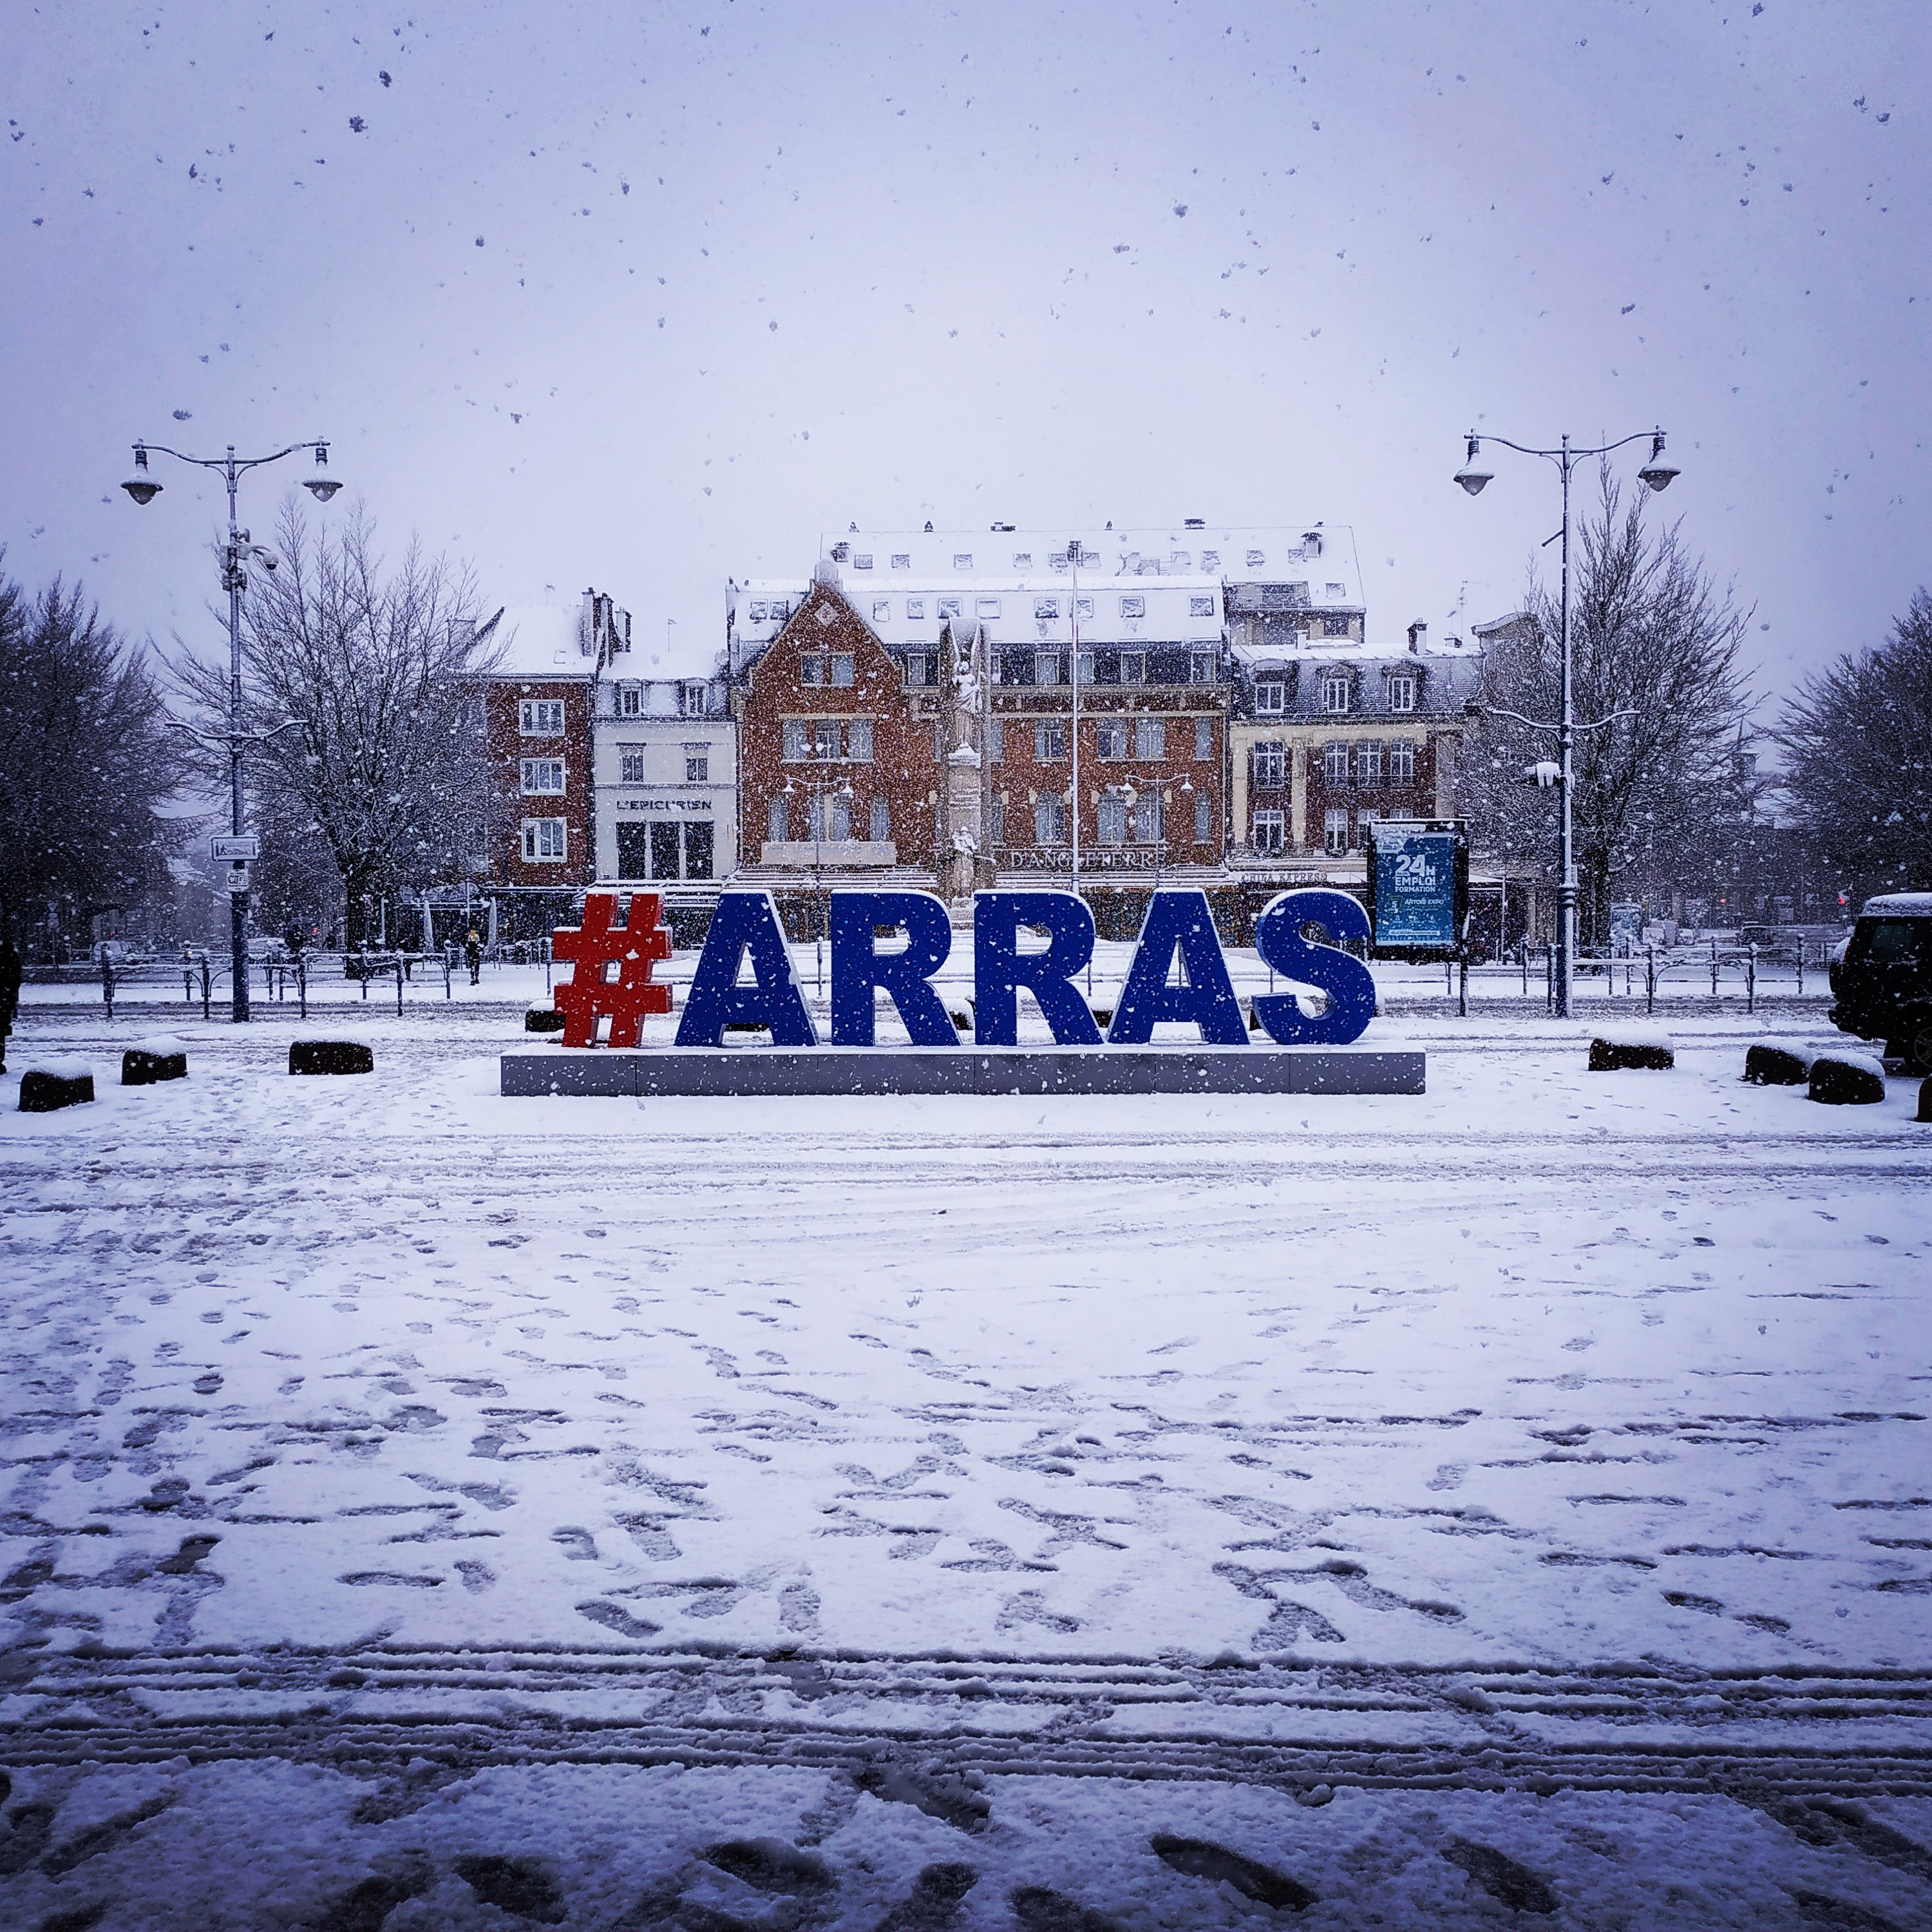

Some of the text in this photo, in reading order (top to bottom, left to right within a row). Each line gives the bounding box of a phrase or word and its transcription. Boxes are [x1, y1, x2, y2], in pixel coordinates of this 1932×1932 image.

[1010, 851, 1166, 868] D'ANGETERRE
[1395, 876, 1437, 886] EMPLOI
[553, 889, 1376, 1047] #ARRAS
